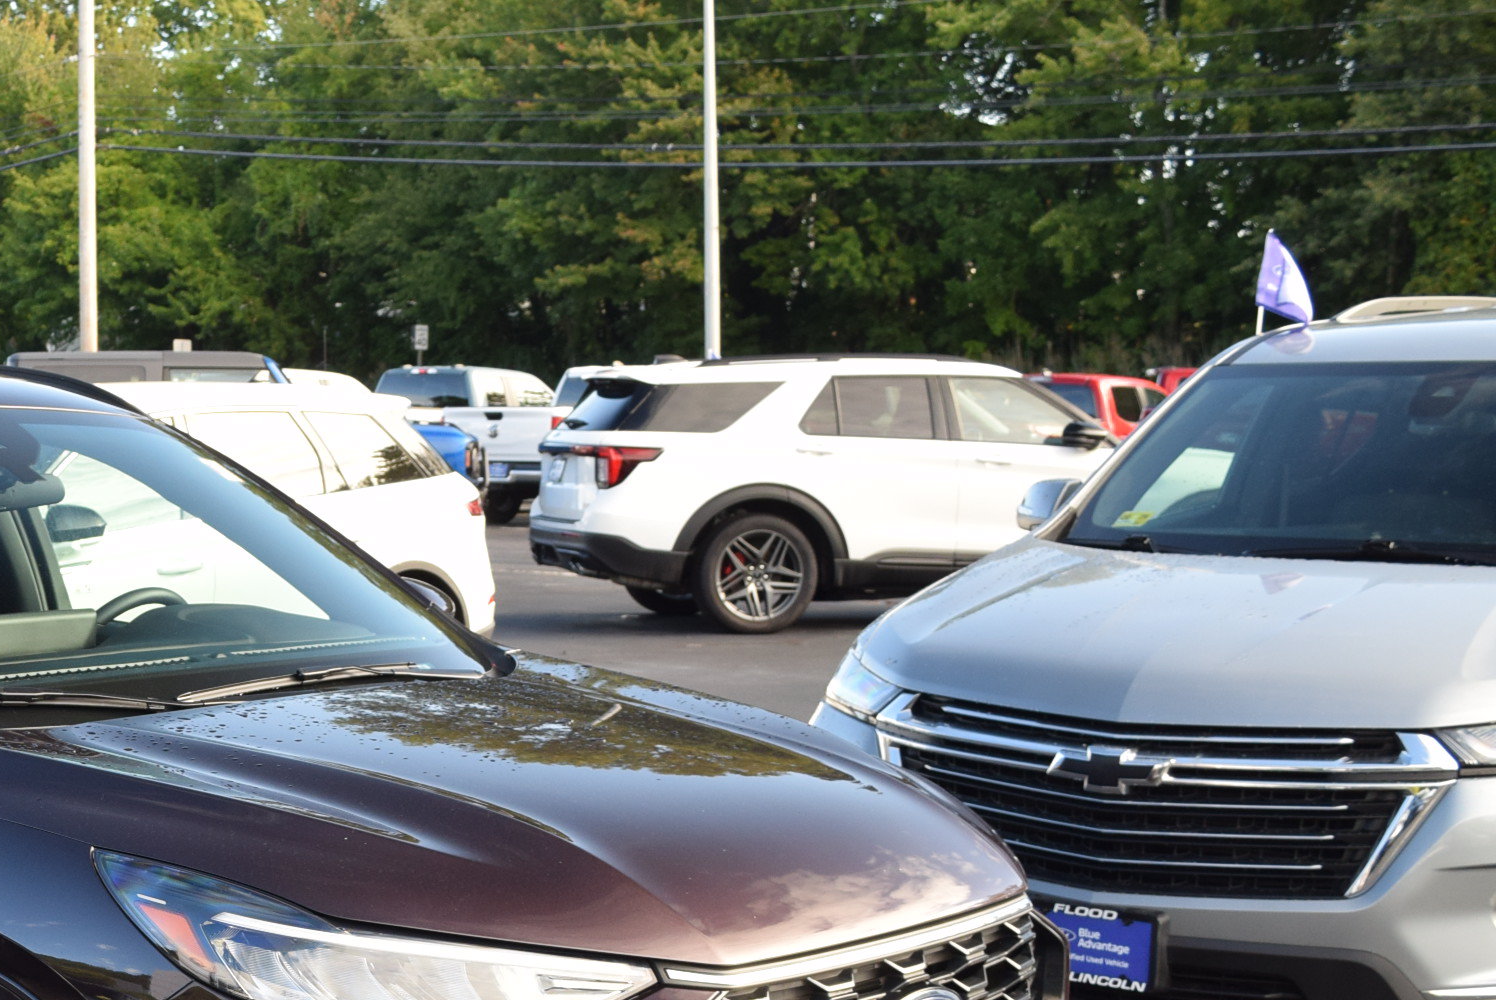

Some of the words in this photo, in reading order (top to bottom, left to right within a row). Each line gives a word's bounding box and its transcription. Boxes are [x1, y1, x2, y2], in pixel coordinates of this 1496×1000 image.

[1053, 903, 1118, 920] FLOOD
[1078, 928, 1101, 940] Blue
[1077, 938, 1130, 955] Advantage
[1069, 971, 1147, 992] LINCOLN
